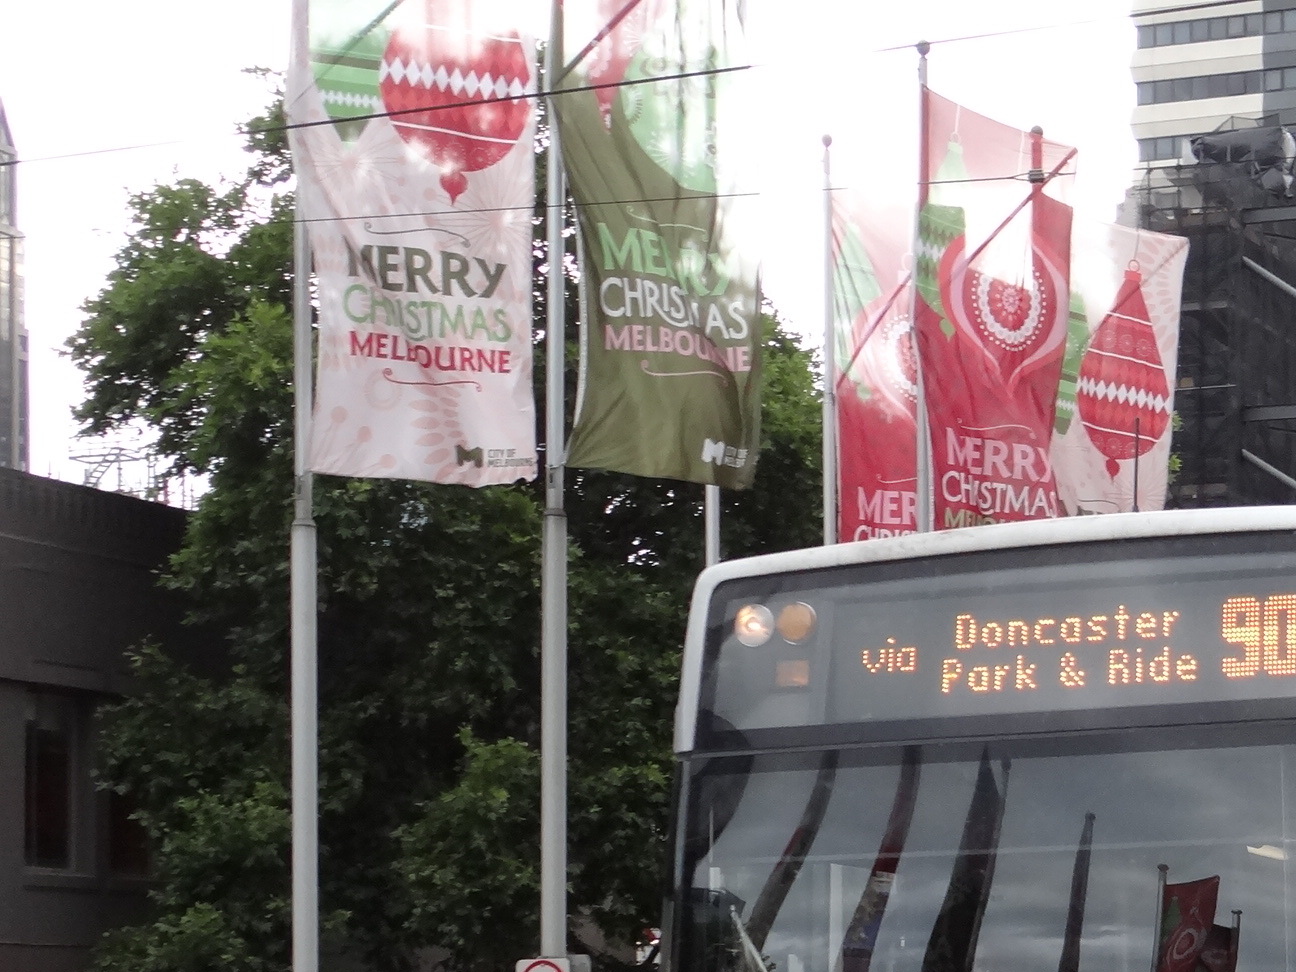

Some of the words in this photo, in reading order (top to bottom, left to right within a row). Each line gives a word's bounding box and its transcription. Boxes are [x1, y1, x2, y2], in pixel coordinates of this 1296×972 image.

[598, 223, 731, 296] MERY
[343, 284, 512, 342] CHISTMAS
[600, 277, 749, 340] CHRISAS
[857, 486, 917, 526] MER
[955, 604, 1180, 651] Doncaster
[861, 637, 917, 674] via
[941, 654, 1038, 693] Park
[1060, 652, 1086, 687] &
[1107, 646, 1198, 685] Ride
